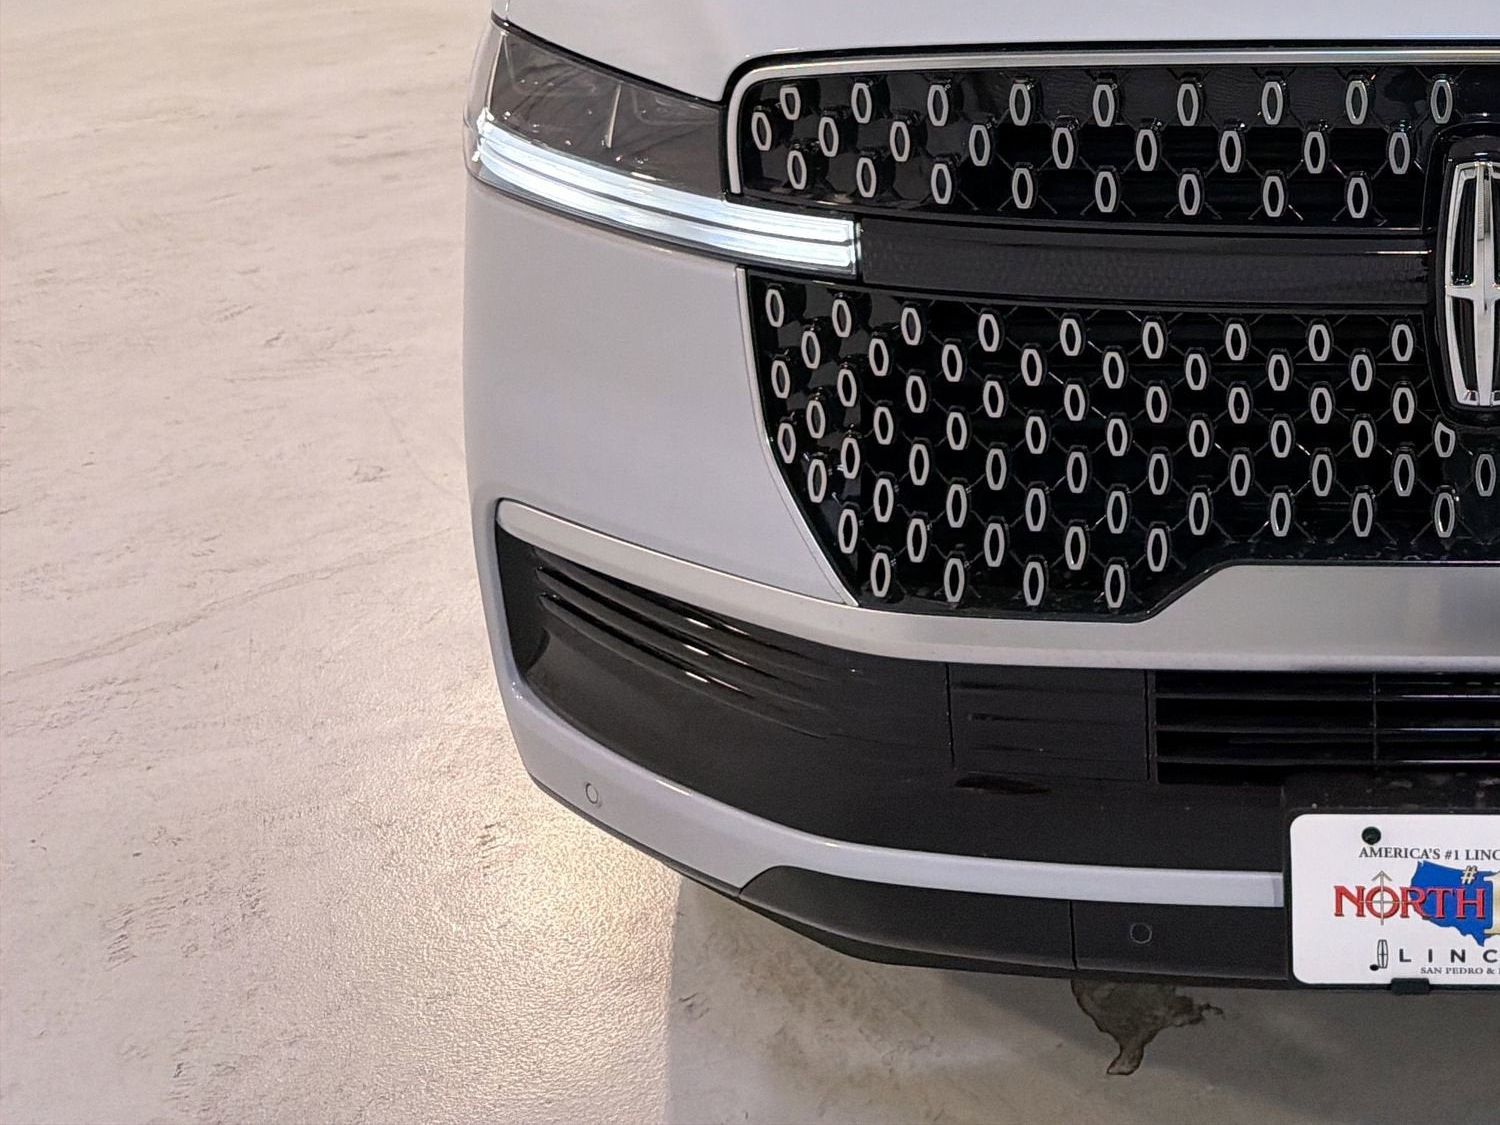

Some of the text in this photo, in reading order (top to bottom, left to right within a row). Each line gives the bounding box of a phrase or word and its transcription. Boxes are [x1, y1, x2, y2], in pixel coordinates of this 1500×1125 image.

[1359, 847, 1441, 860] AMERICA'S
[1445, 849, 1460, 860] #1
[1334, 885, 1486, 920] NORTH
[1420, 966, 1443, 975] SAN
[1445, 966, 1484, 976] PEDRO
[1486, 966, 1496, 976] &
